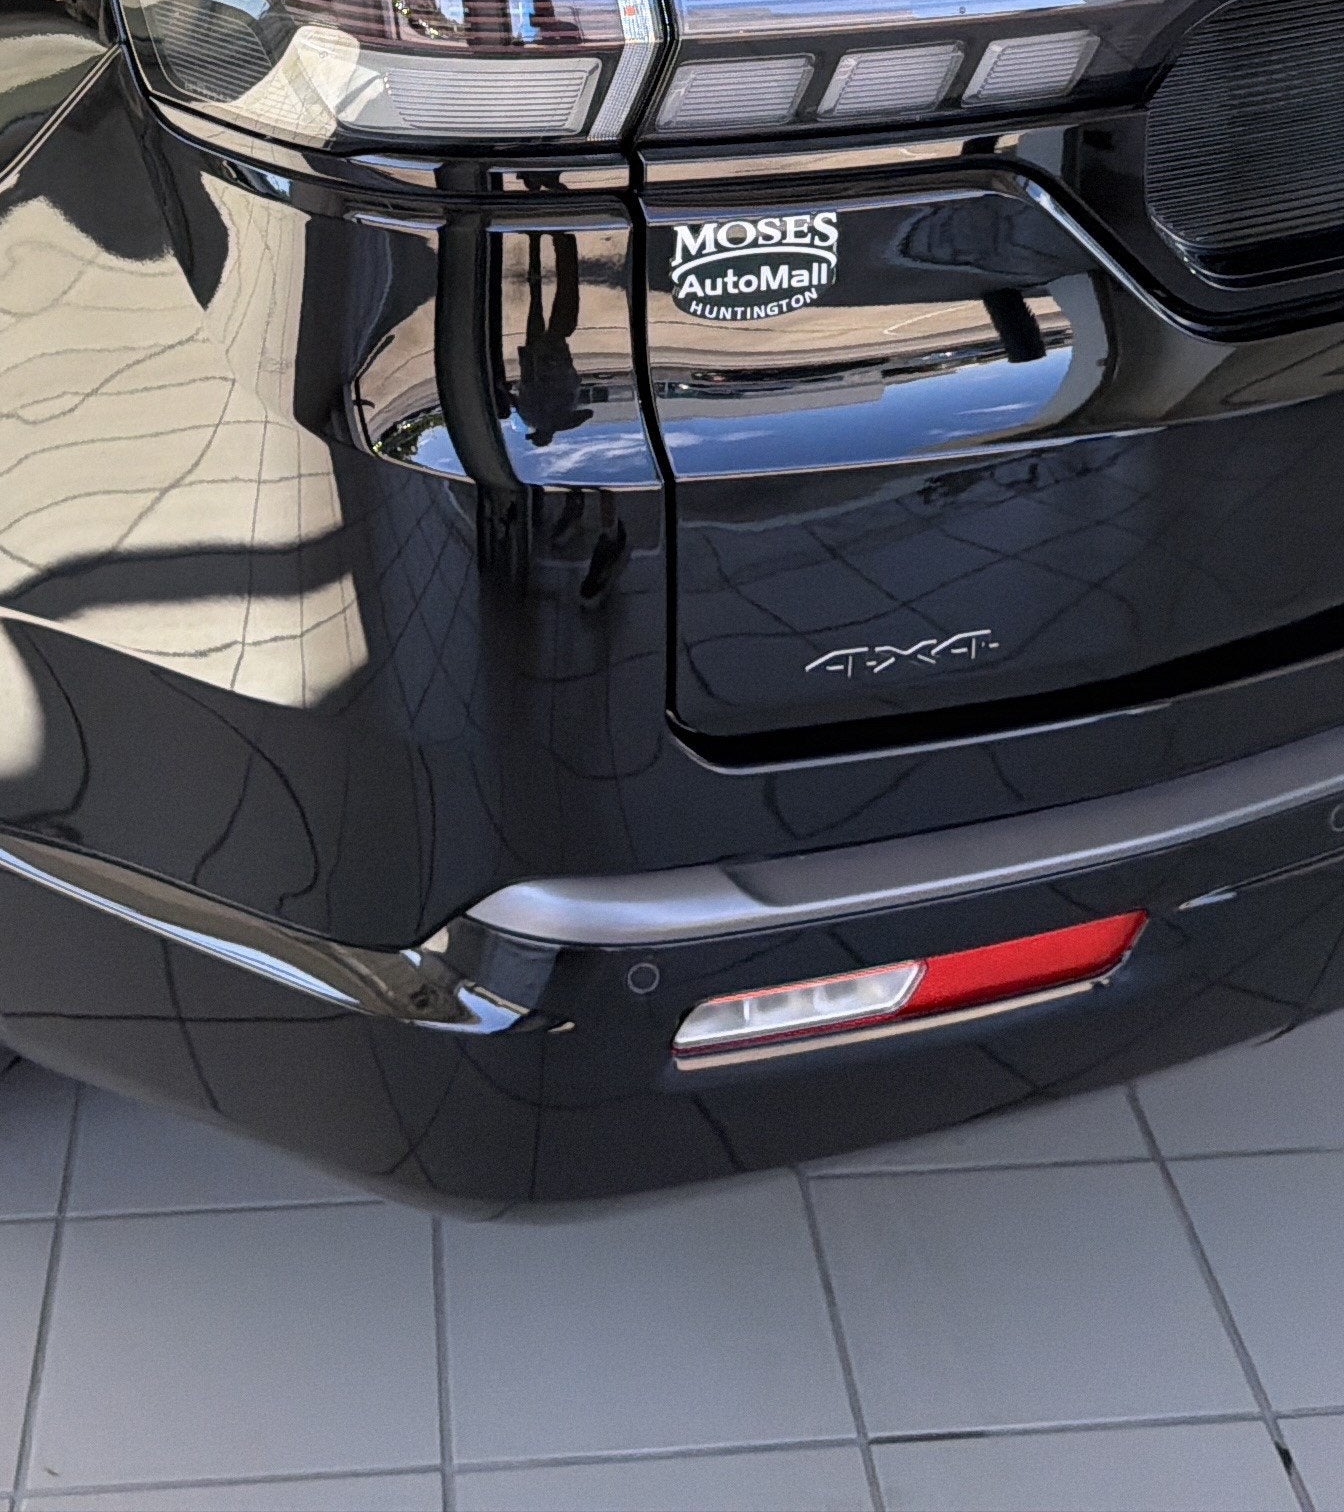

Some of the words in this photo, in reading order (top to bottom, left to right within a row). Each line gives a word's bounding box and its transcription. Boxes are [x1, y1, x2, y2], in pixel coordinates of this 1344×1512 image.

[671, 211, 839, 267] MOSES
[677, 262, 828, 299] AutoMall
[689, 289, 819, 320] HUNTINGTON
